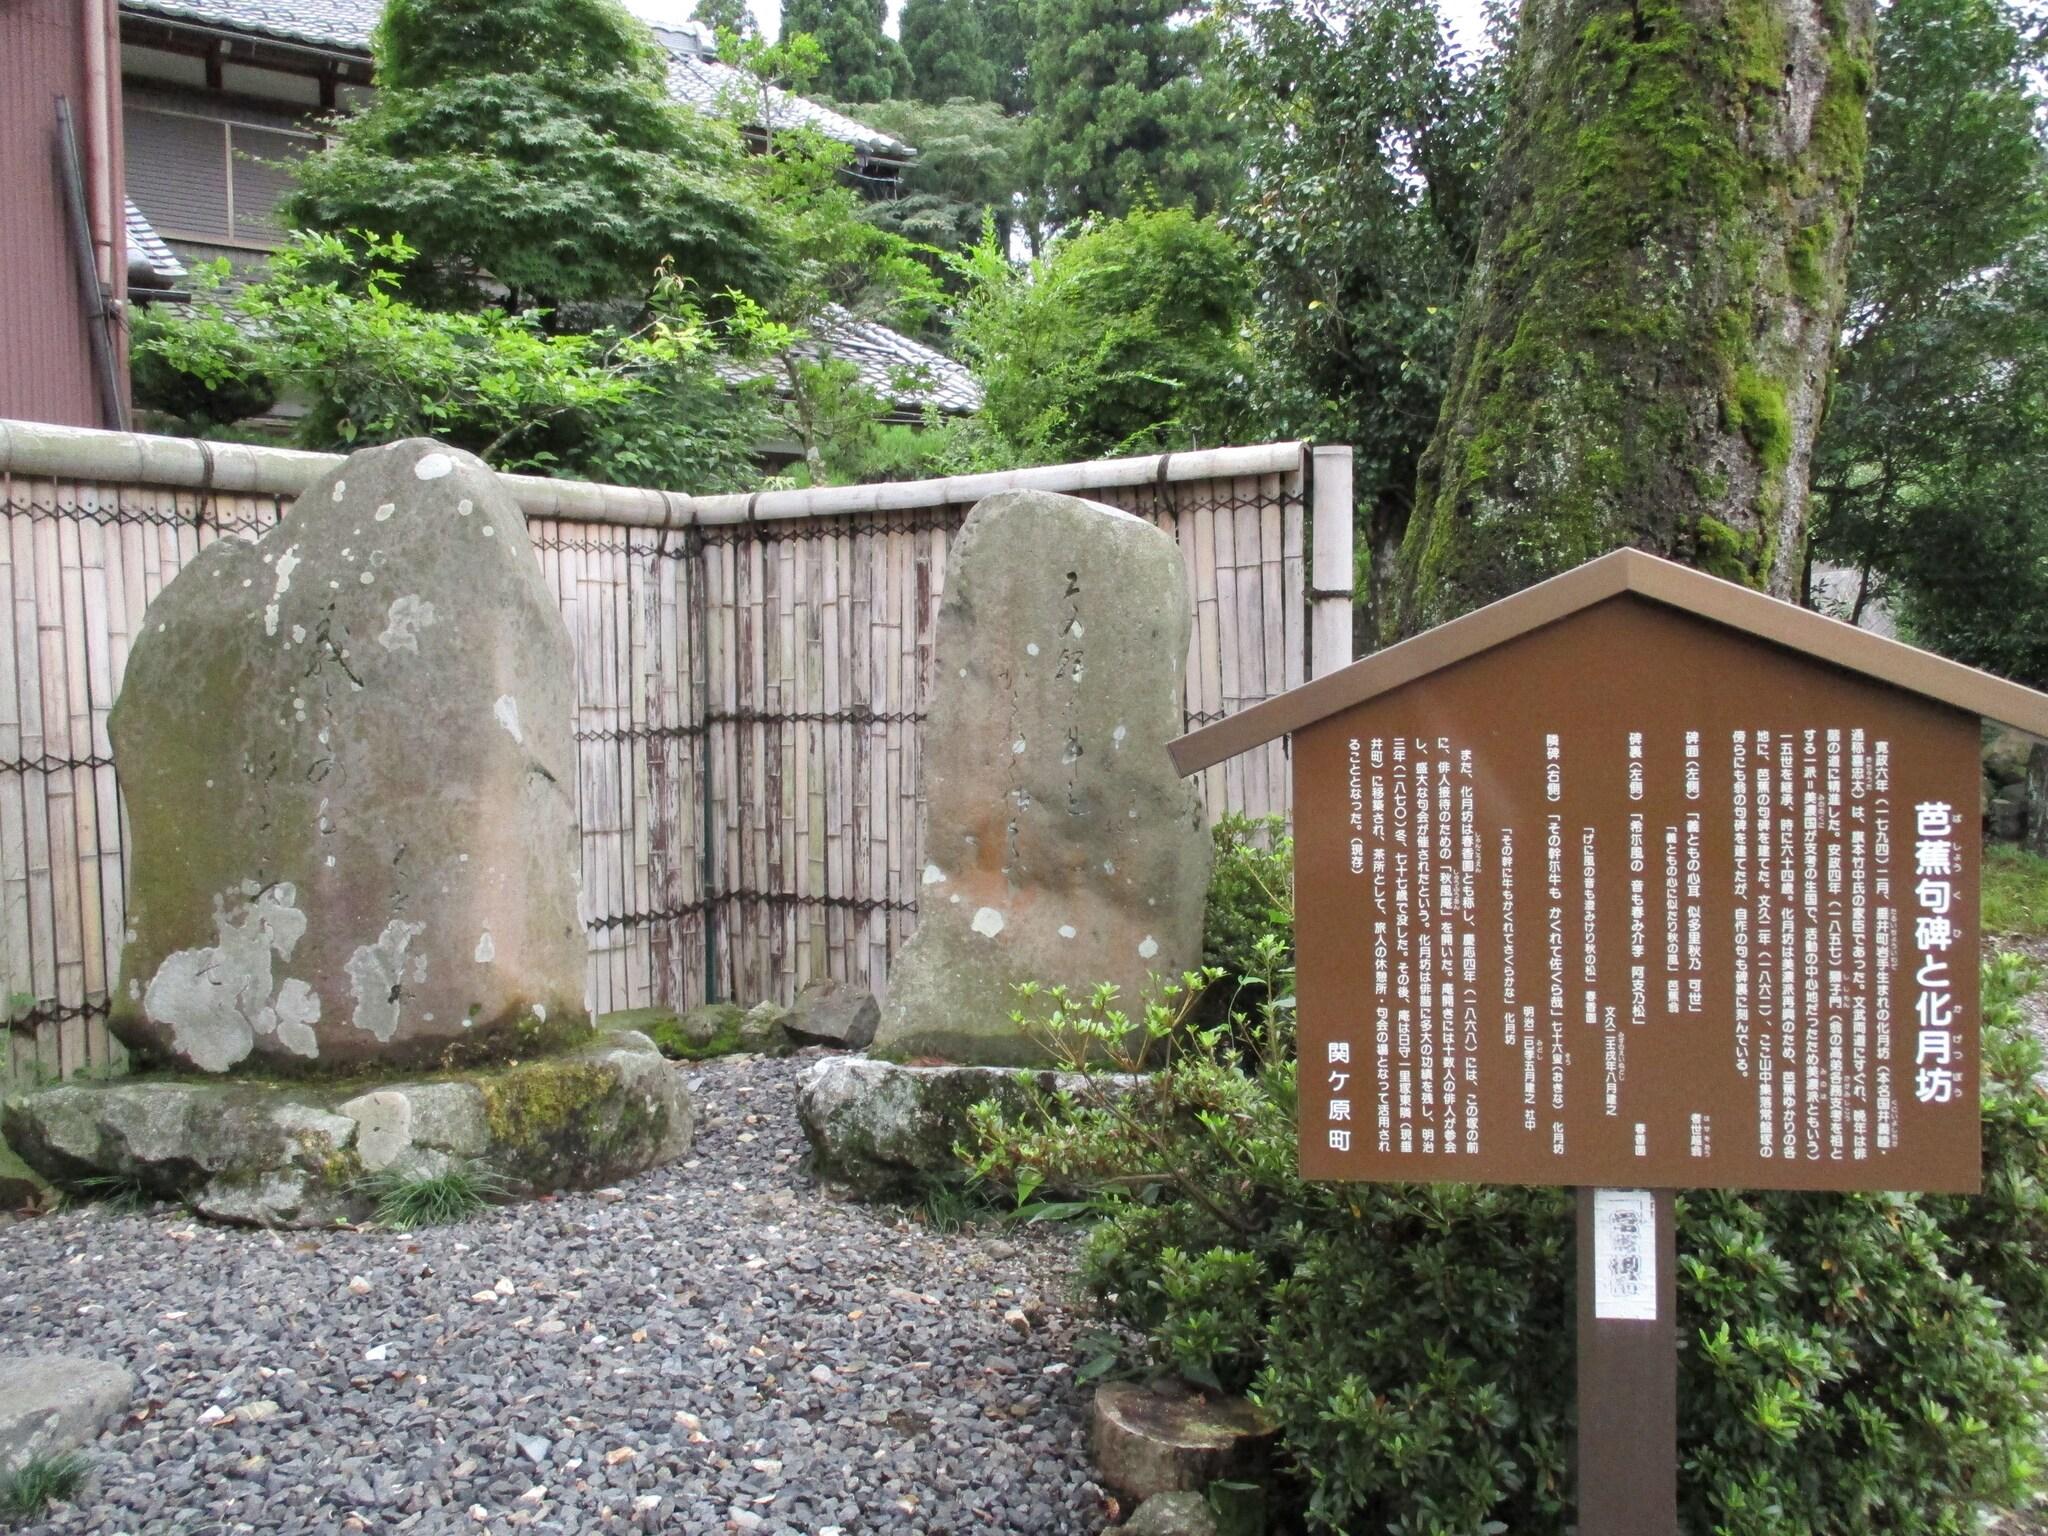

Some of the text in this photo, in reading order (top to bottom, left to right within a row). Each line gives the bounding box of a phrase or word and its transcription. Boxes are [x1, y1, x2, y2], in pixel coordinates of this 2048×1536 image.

[1348, 738, 1364, 874] ることとなった。（現存）
[1628, 731, 1644, 801] 碑裏（左側）
[1685, 730, 1700, 800] 碑面（左側）
[1370, 737, 1391, 1153] 井町）に移築され、茶所として、旅人の休憩所・句会の場となって活用され
[1415, 737, 1435, 1154] し、盛大な句会が催されたという。化月坊は俳諧に多大の功績を残し、明治
[1914, 800, 1952, 1104] 芭蕉句碑と化月坊
